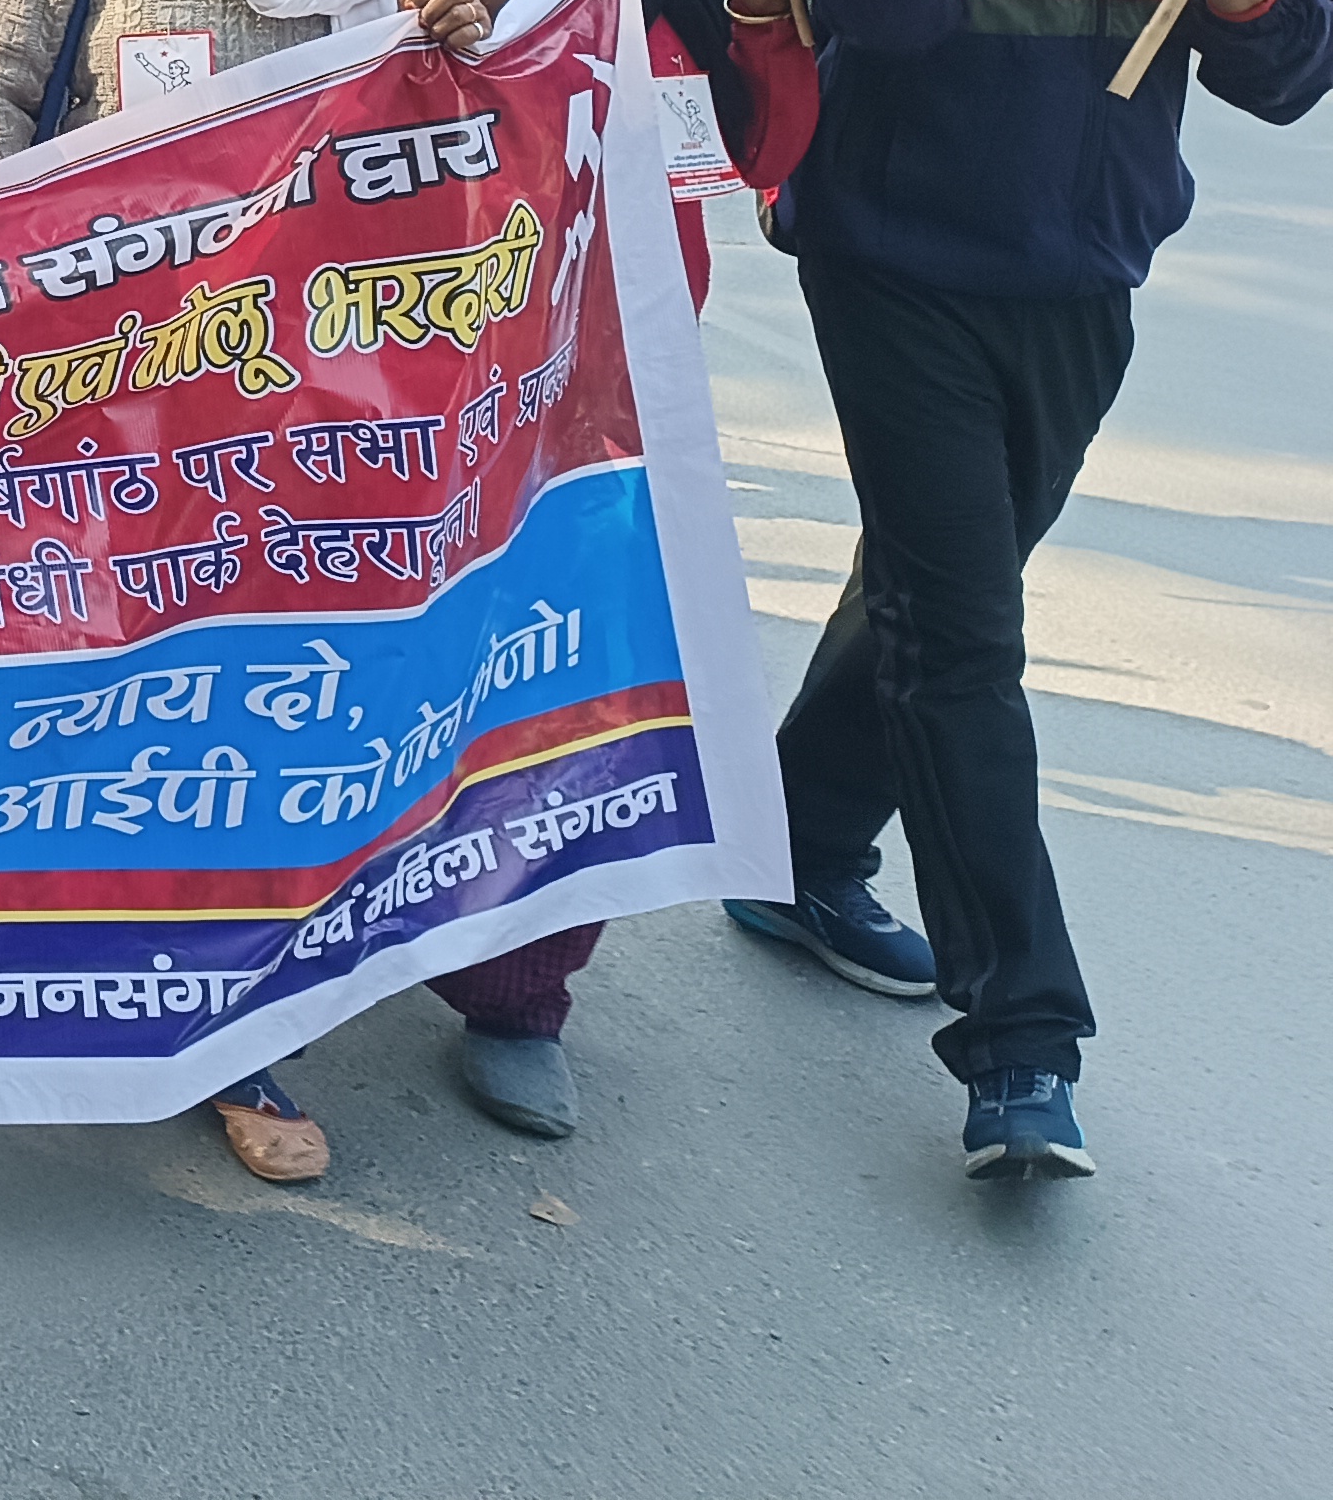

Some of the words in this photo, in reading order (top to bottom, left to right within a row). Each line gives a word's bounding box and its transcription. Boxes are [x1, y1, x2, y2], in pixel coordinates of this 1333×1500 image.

[335, 112, 498, 200] द्वारा
[7, 316, 135, 439] एवं
[309, 204, 541, 351] भरदारी
[174, 431, 282, 504] पर
[291, 414, 446, 484] सभा
[458, 363, 507, 467] एवं
[112, 512, 250, 614] पार्क
[10, 665, 222, 750] न्याय
[245, 637, 365, 732] दो,
[279, 737, 391, 826] को
[393, 687, 468, 789] जेल
[292, 882, 364, 961] एवं
[363, 827, 498, 924] महिला
[505, 771, 678, 861] संगठन
